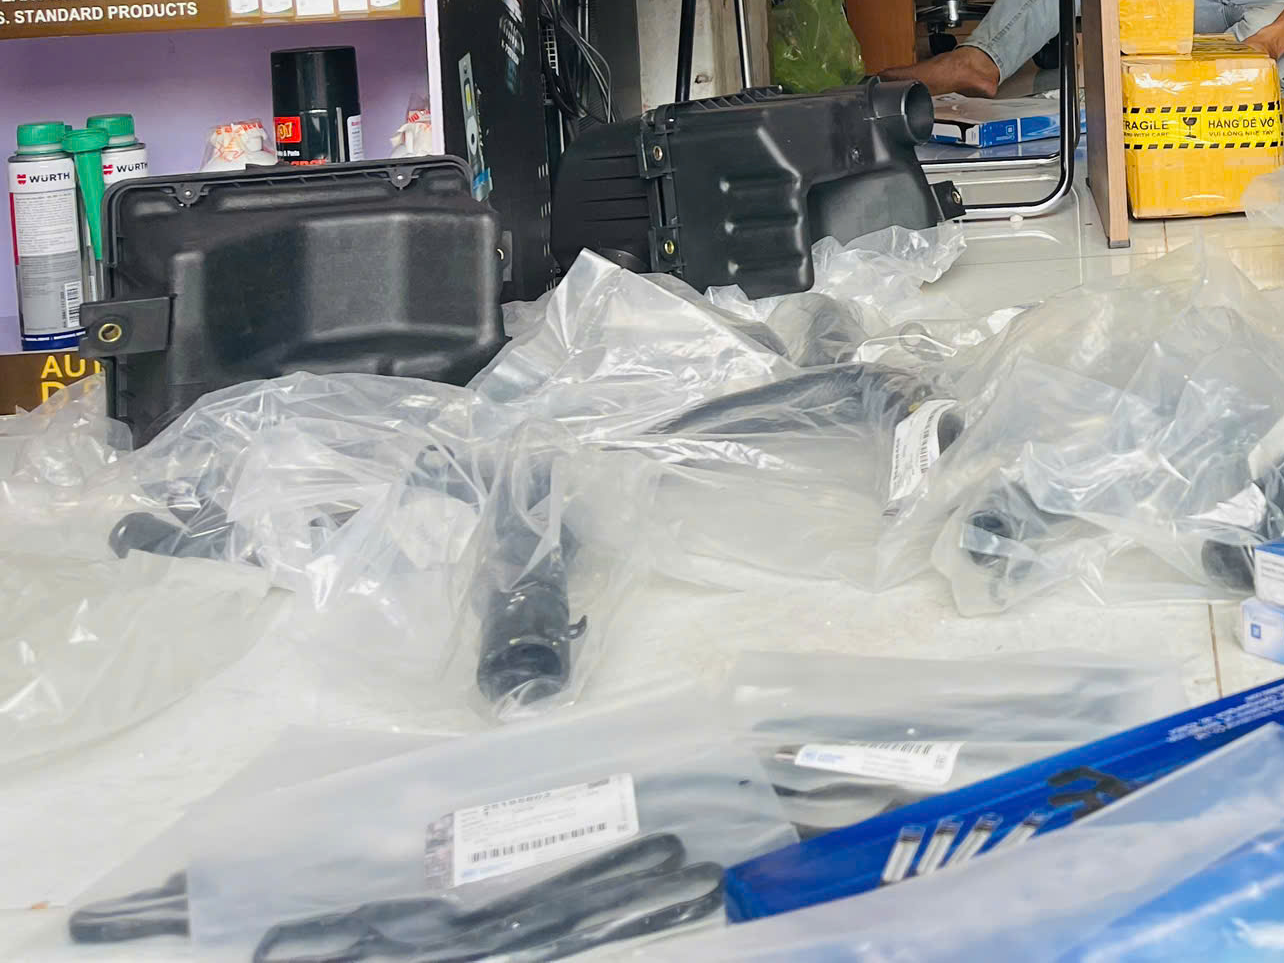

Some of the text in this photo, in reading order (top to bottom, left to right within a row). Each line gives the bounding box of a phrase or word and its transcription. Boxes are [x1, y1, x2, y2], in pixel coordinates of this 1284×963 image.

[14, 6, 104, 23] STANDARD
[108, 2, 198, 19] PRODUCTS
[116, 162, 148, 174] WÜRTH
[29, 172, 71, 183] WÜRTH
